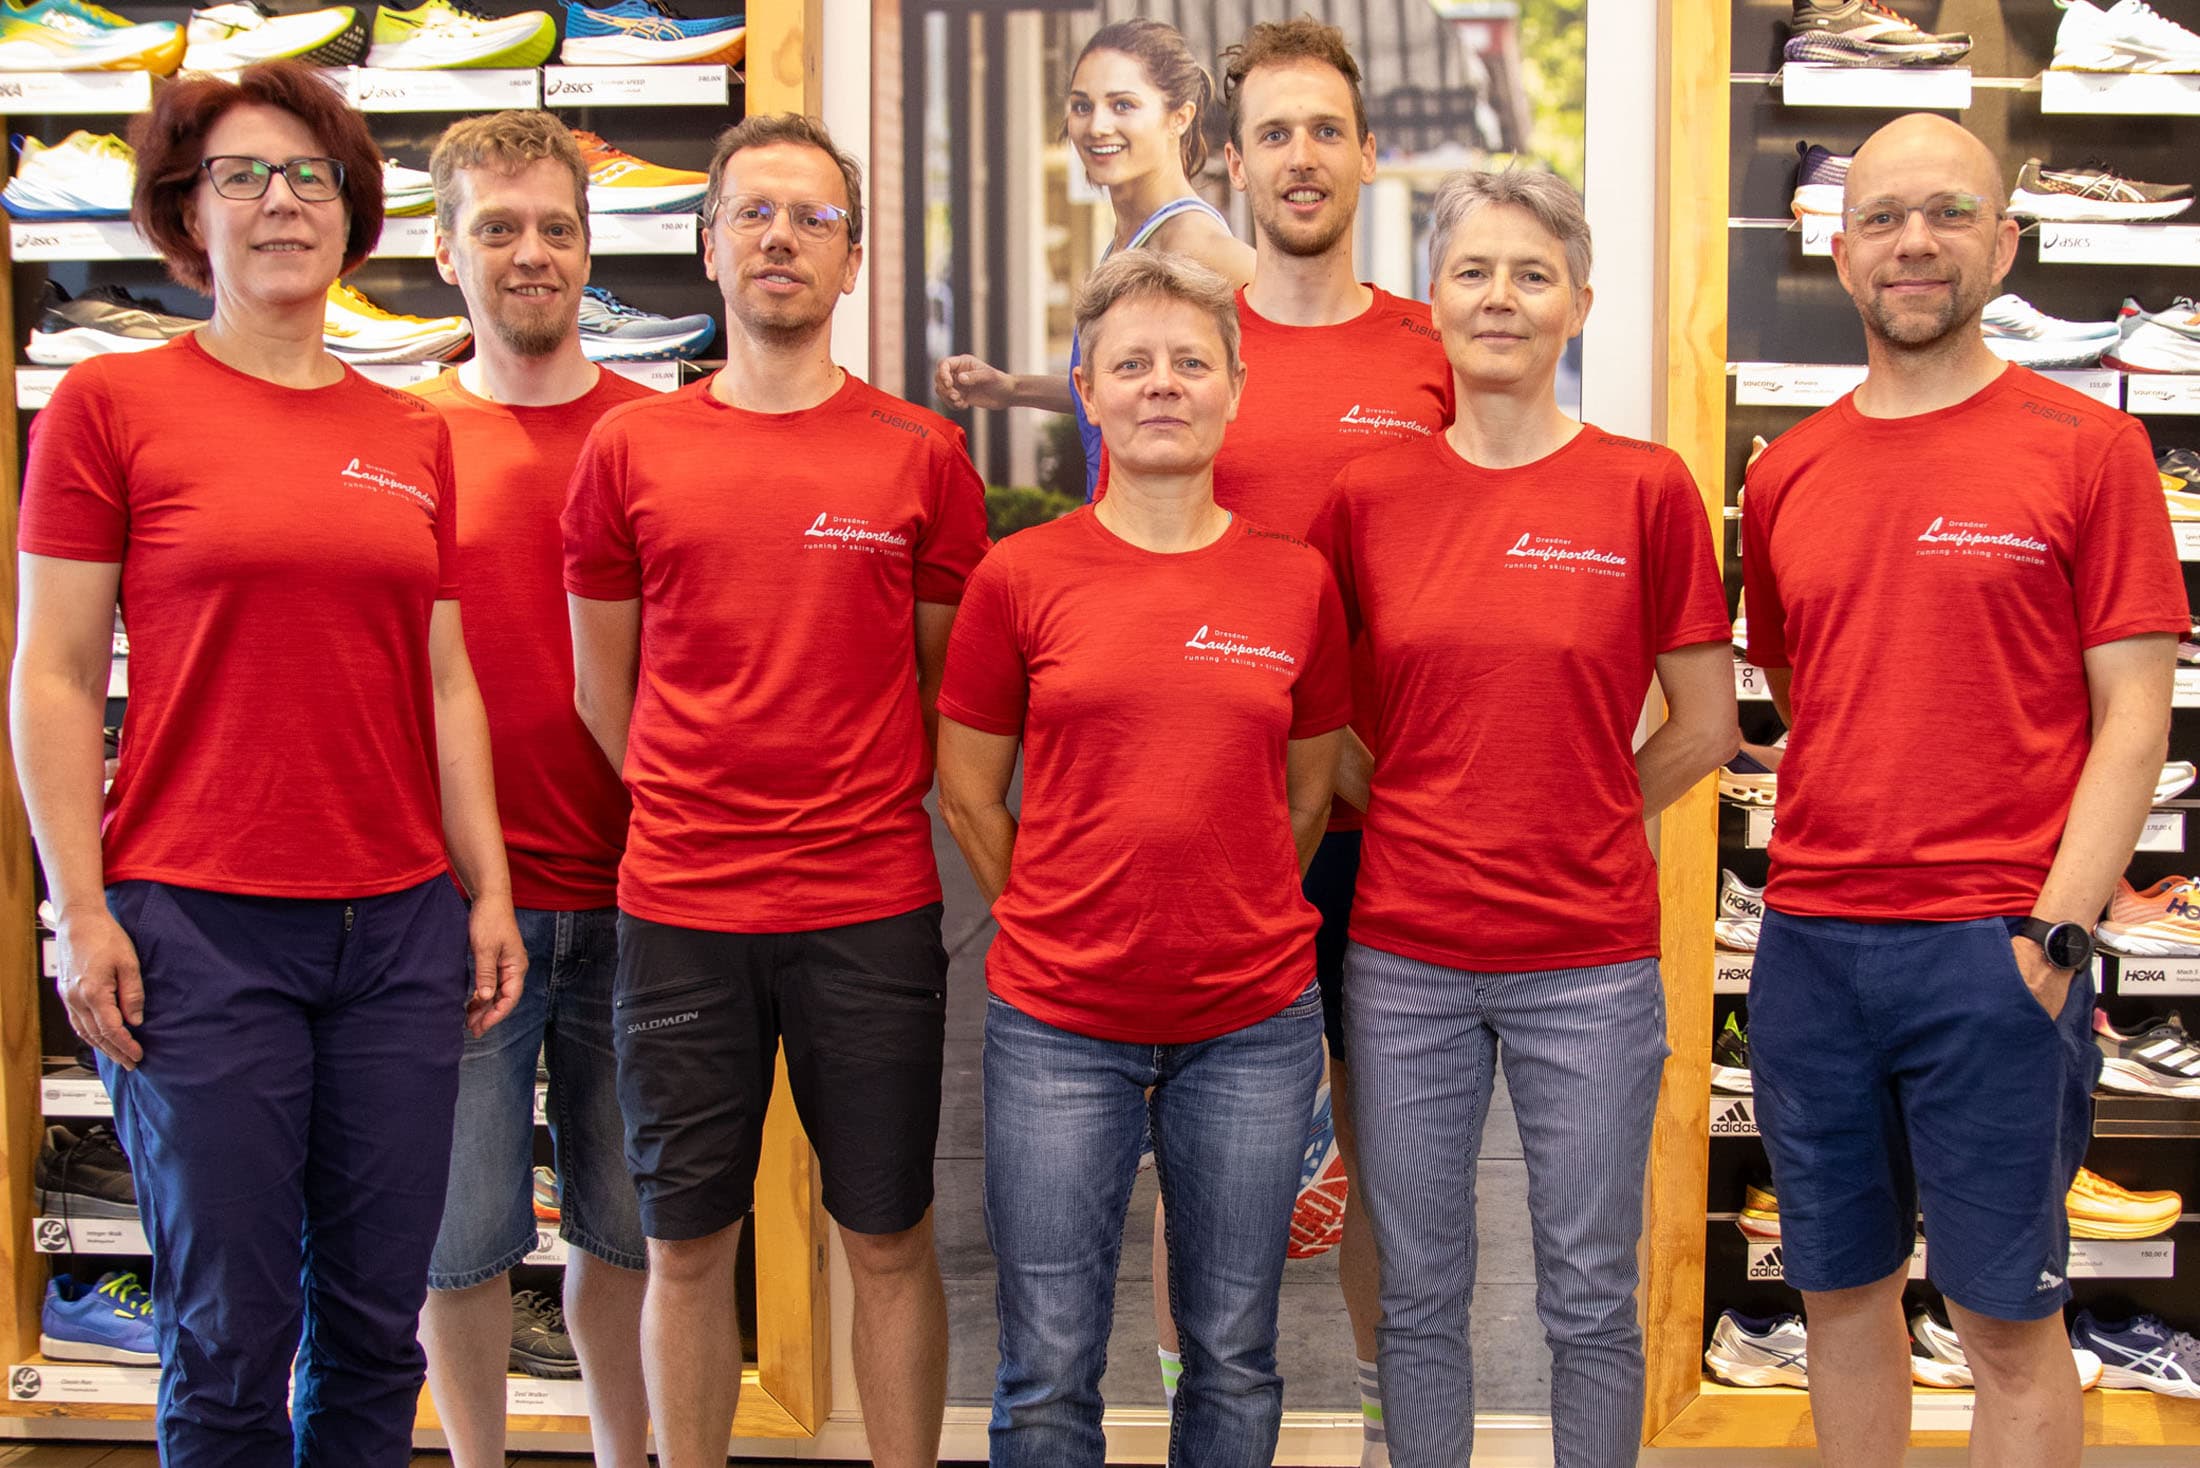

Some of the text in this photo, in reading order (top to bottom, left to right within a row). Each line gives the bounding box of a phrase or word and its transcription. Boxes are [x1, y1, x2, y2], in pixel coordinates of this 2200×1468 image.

[562, 81, 593, 95] asics
[2058, 237, 2091, 248] asics
[1400, 317, 1443, 343] FUSIO
[1340, 404, 1432, 436] Laufsportlade
[2021, 400, 2085, 429] FUSION
[870, 408, 930, 439] FUSION
[832, 515, 870, 526] Dresdner
[1948, 520, 1989, 529] Dresdner
[1534, 536, 1572, 546] Dresdner
[1917, 515, 2049, 553] Laufsportladen
[803, 542, 838, 551] running
[848, 543, 876, 554] skiing
[1505, 531, 1628, 565] Laufsportladen
[1916, 548, 1951, 557] running
[1961, 548, 1992, 558] skiing
[1503, 562, 1627, 578] running skiing triathlon
[1214, 629, 1249, 641] Dresdner
[1184, 624, 1296, 665] Laufsportladen
[1183, 654, 1220, 663] running
[1230, 657, 1257, 668] skiing
[1724, 892, 1763, 919] HOKA
[2165, 897, 2200, 921] HO
[1717, 967, 1751, 981] HOK
[2124, 969, 2166, 982] HOKA
[626, 1010, 700, 1035] SALOMON
[1750, 1265, 1784, 1277] adid
